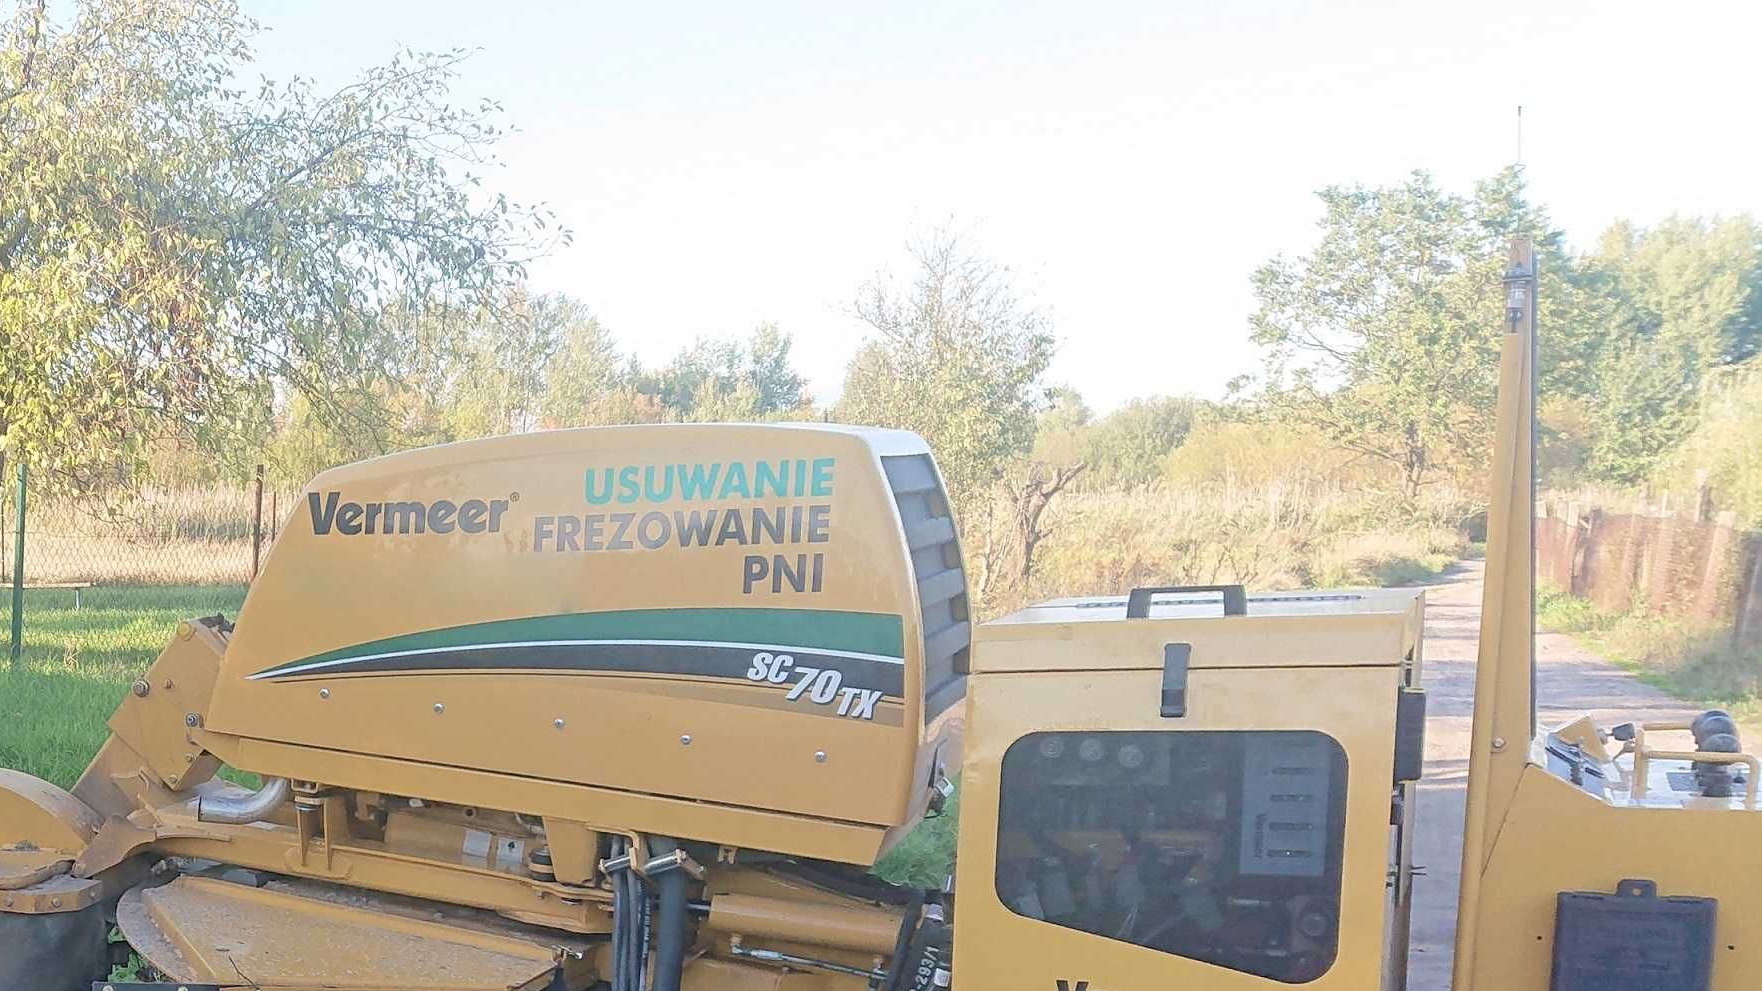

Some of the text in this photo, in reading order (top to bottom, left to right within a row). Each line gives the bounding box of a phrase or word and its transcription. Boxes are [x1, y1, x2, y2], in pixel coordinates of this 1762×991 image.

[583, 457, 835, 505] USUWANIE
[533, 504, 831, 552] FREZOWANIE
[742, 553, 824, 594] PNI
